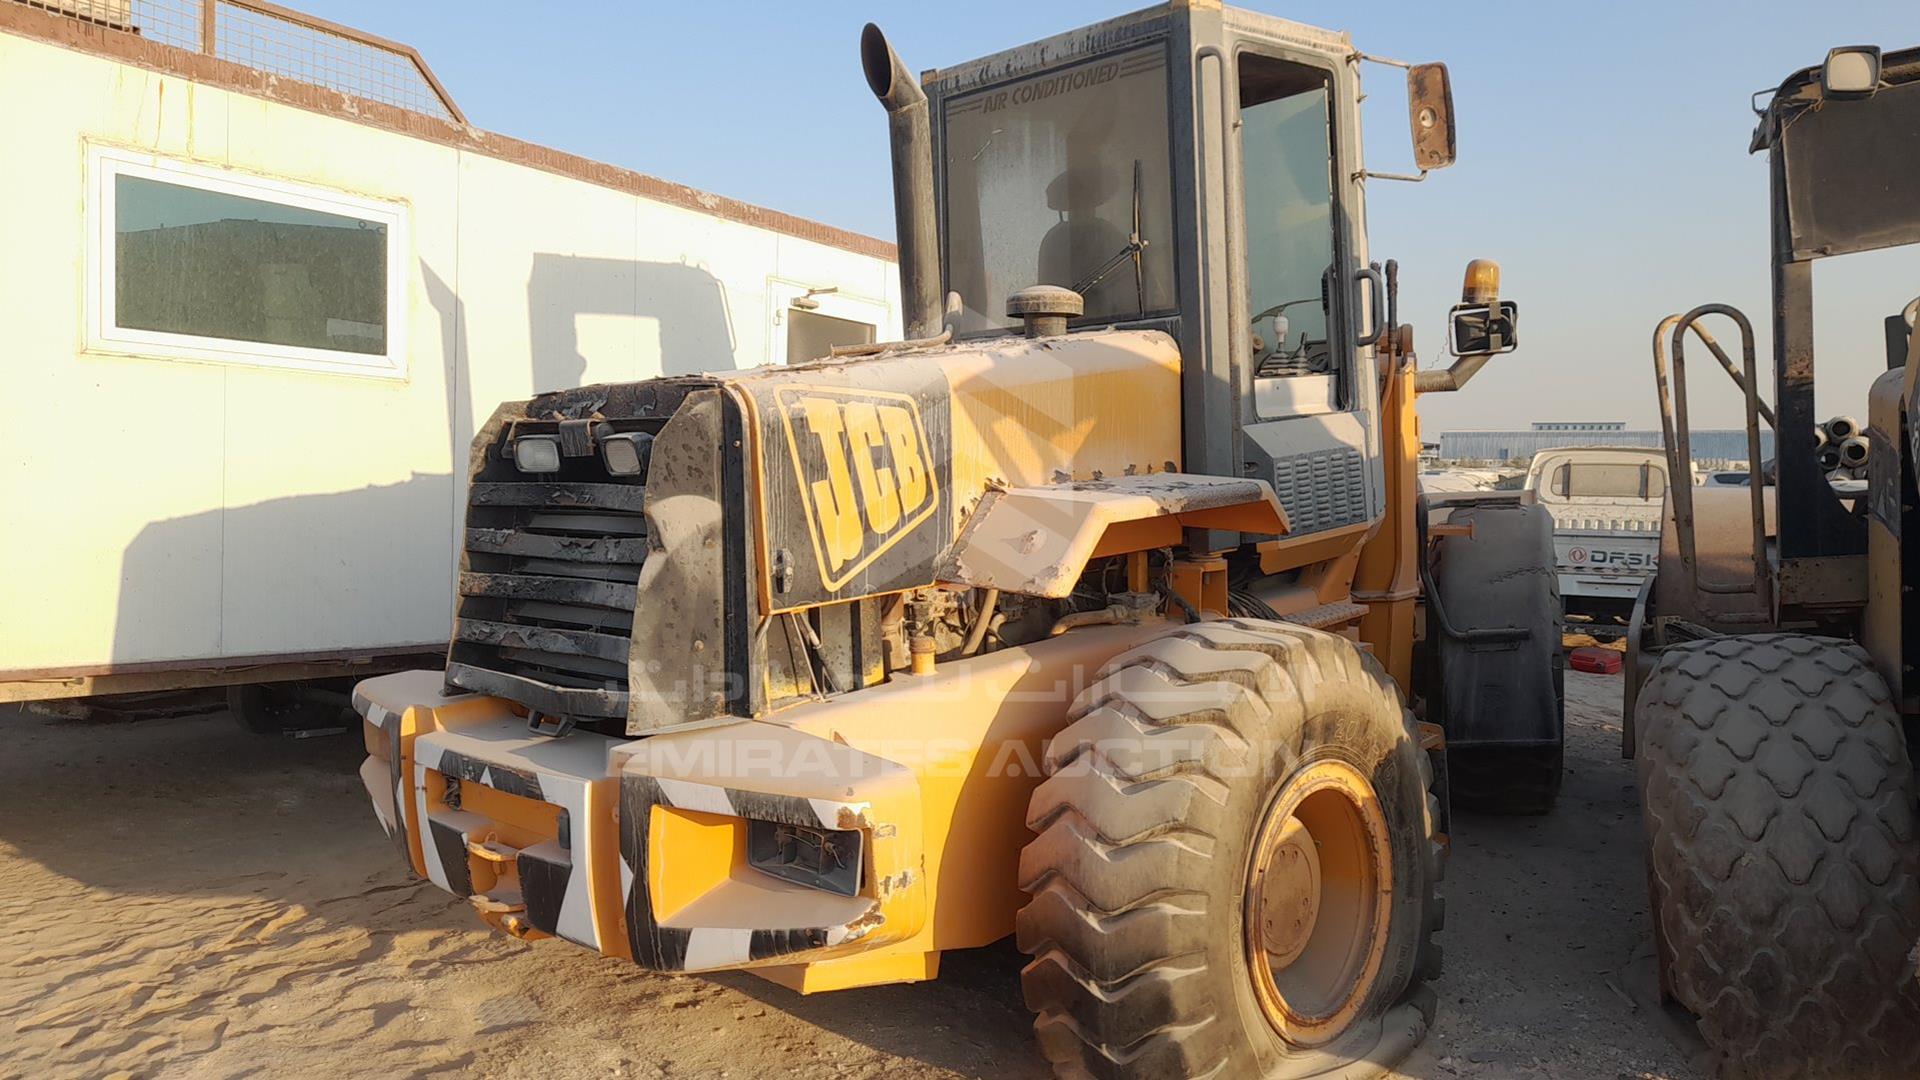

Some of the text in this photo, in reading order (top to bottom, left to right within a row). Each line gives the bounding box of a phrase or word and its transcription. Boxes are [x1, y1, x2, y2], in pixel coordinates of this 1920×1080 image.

[983, 62, 1120, 114] AIR CONDITIONED
[792, 397, 927, 573] JCB
